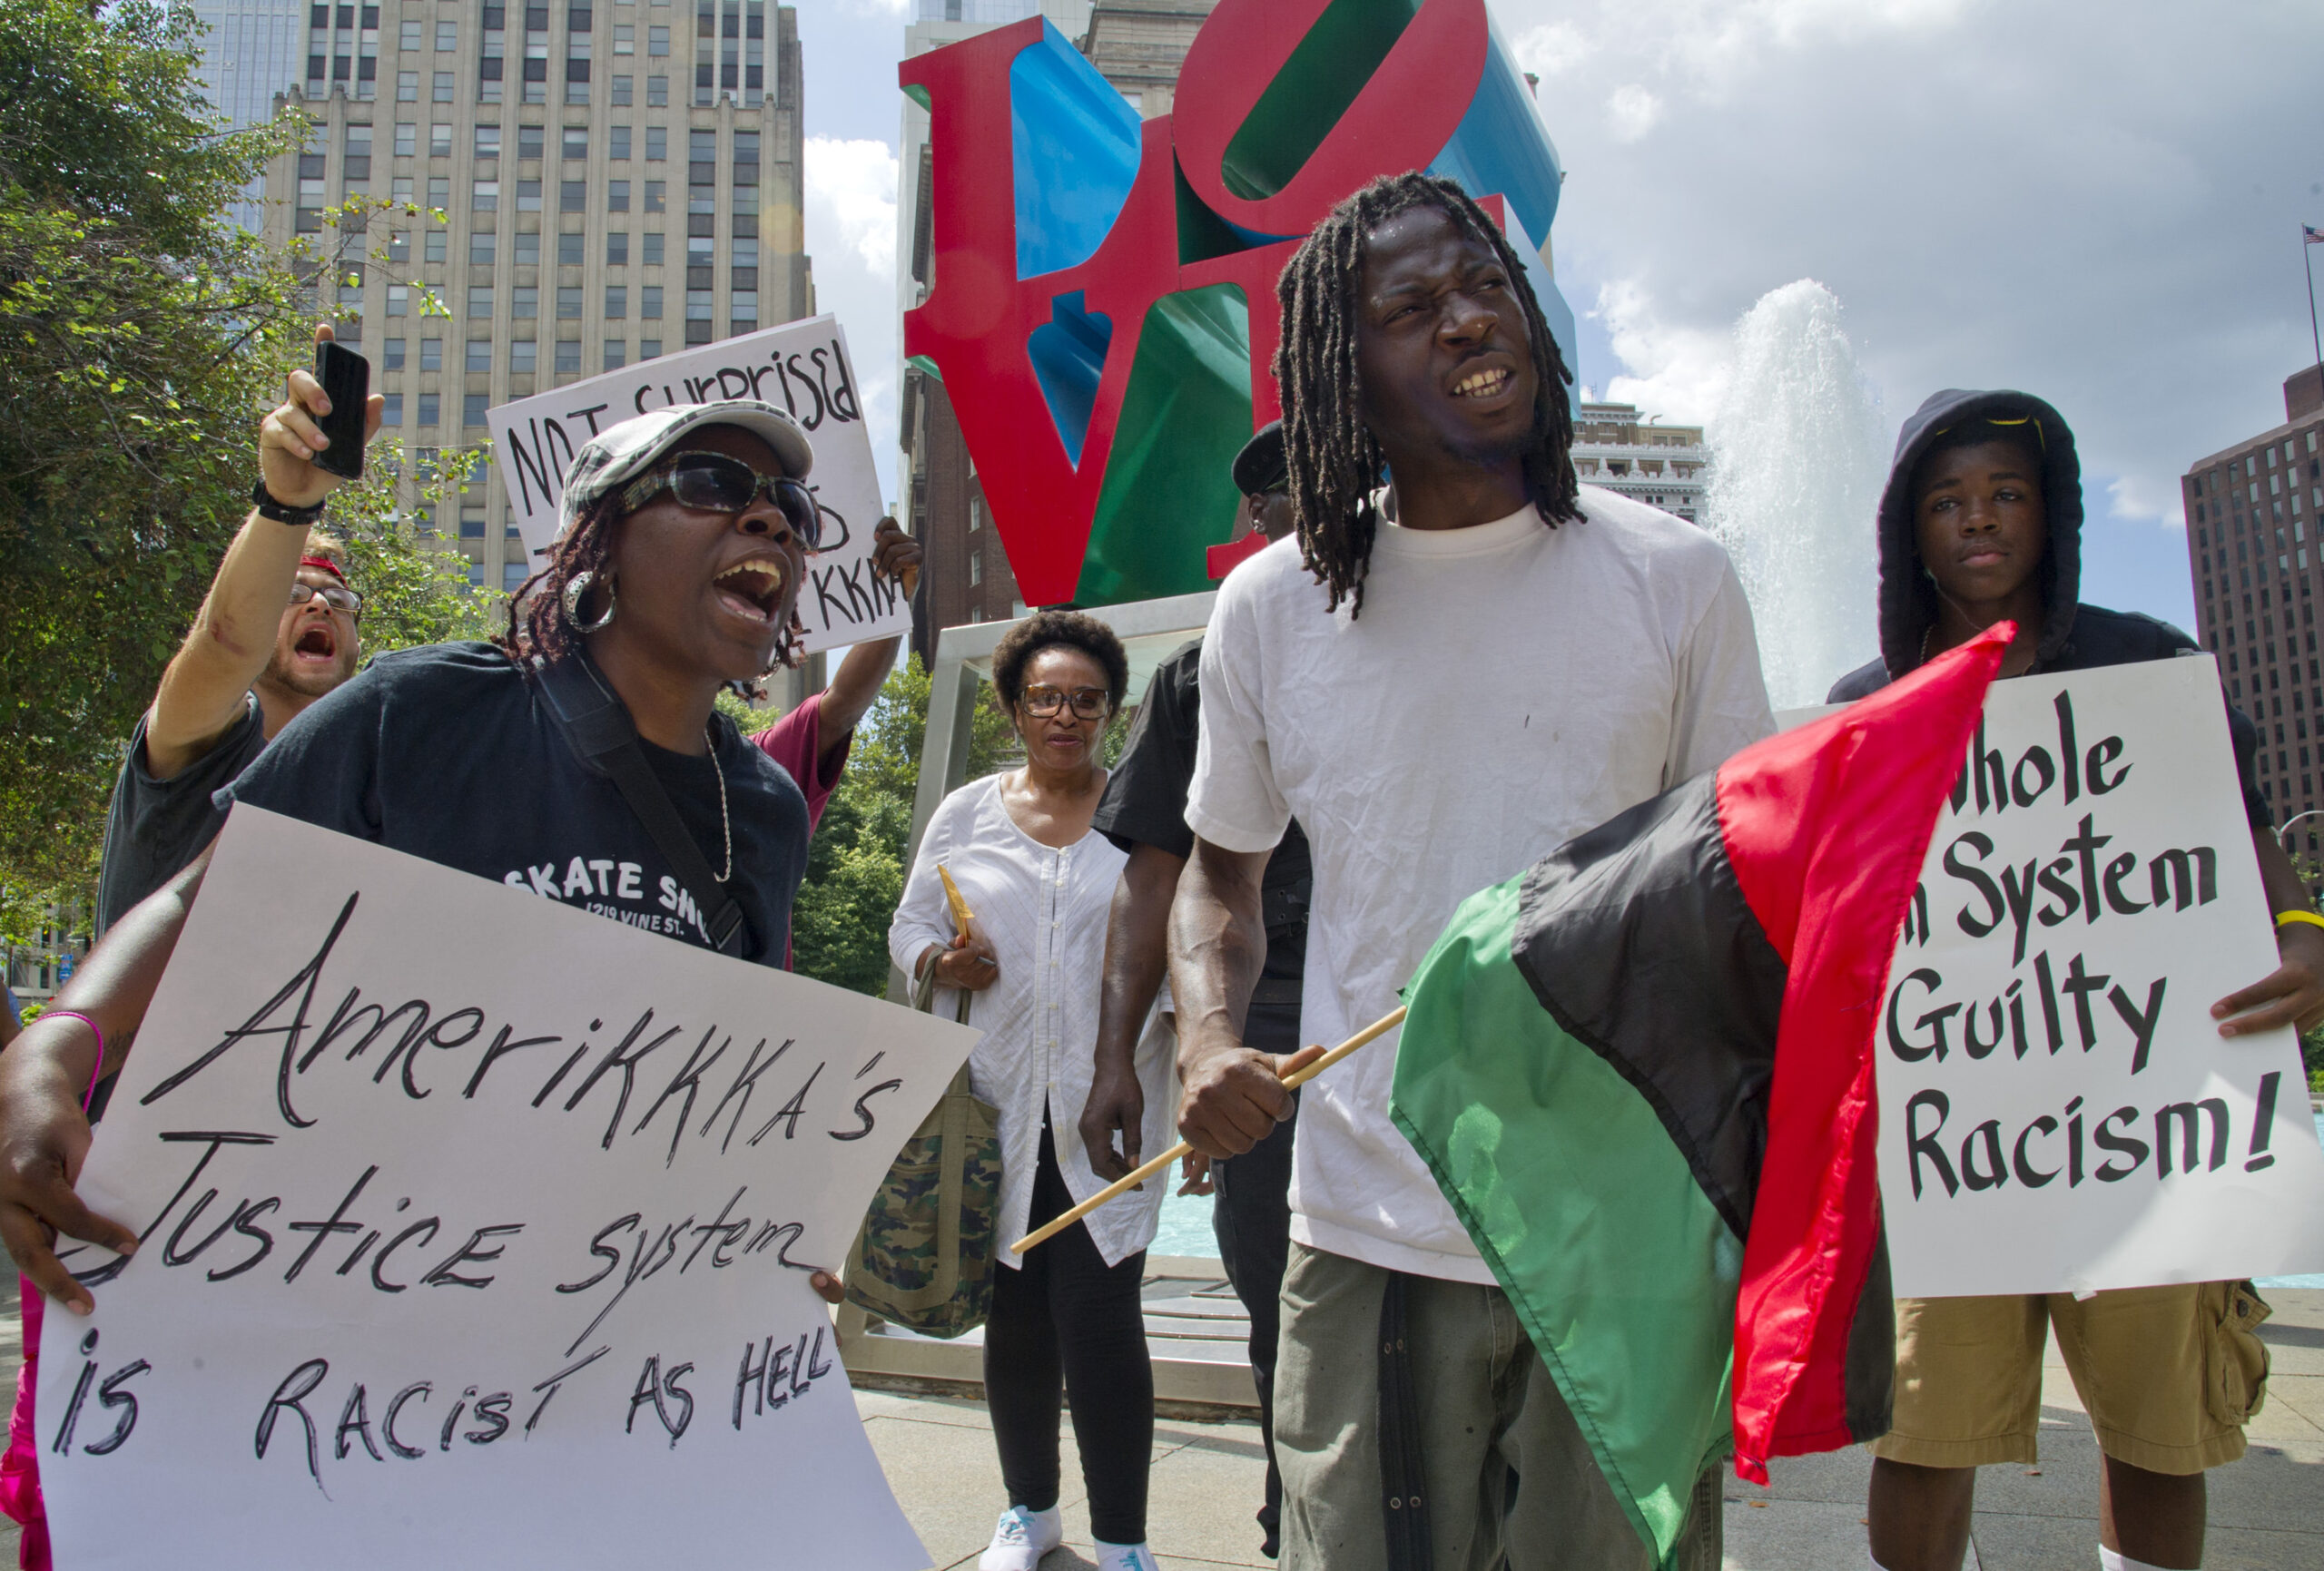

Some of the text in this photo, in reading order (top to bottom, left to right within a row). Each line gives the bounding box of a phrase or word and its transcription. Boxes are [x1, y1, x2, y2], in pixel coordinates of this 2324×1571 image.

[1948, 688, 2134, 817] hole
[503, 856, 644, 900] SKATE
[620, 909, 661, 931] VINE
[664, 917, 685, 936] ST.
[1904, 812, 2219, 968] n System
[1886, 949, 2168, 1075] Guilty
[1905, 1071, 2281, 1203] Racism!
[625, 1353, 694, 1451] AS
[732, 1325, 833, 1432] HELL
